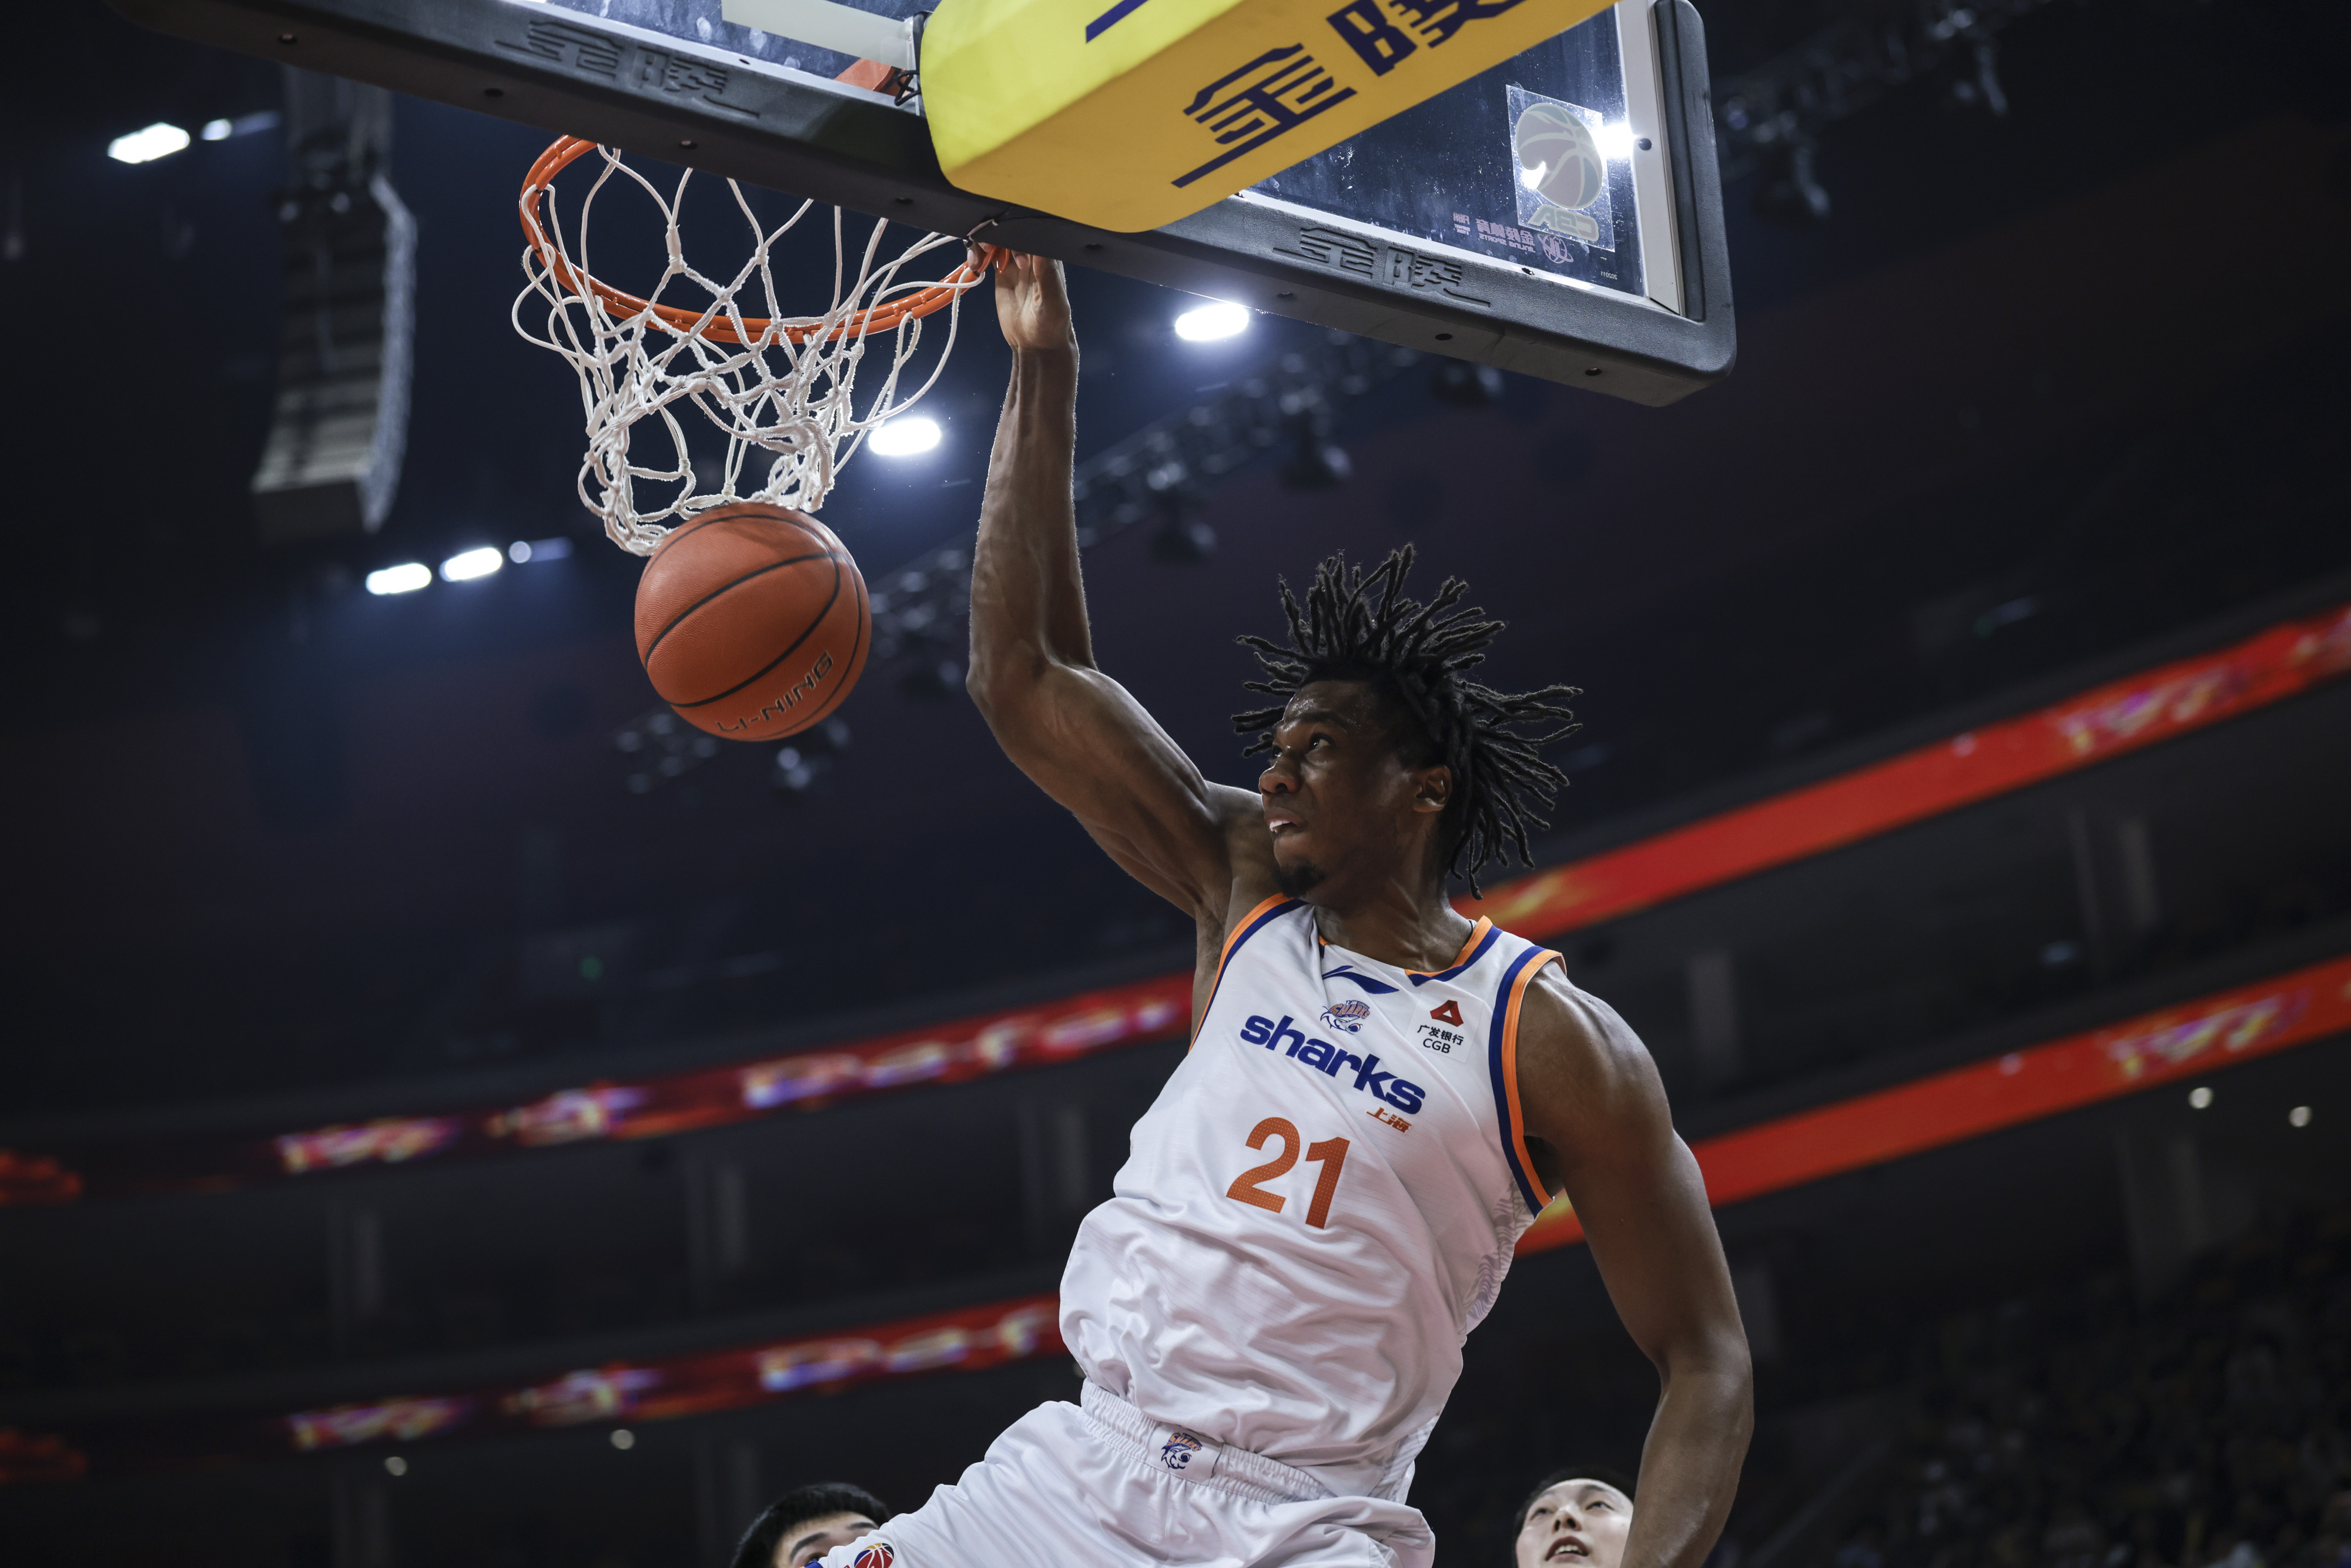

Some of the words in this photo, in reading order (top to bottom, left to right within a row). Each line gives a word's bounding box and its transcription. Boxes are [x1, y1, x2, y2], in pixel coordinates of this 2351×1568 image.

[716, 650, 833, 732] LI-NING
[1329, 1003, 1370, 1020] SHARKS
[1417, 1025, 1464, 1046] 广发银行
[1423, 1038, 1451, 1054] CGB
[1240, 1015, 1426, 1114] sharks
[1365, 1107, 1412, 1133] 上海
[1225, 1117, 1351, 1229] 21
